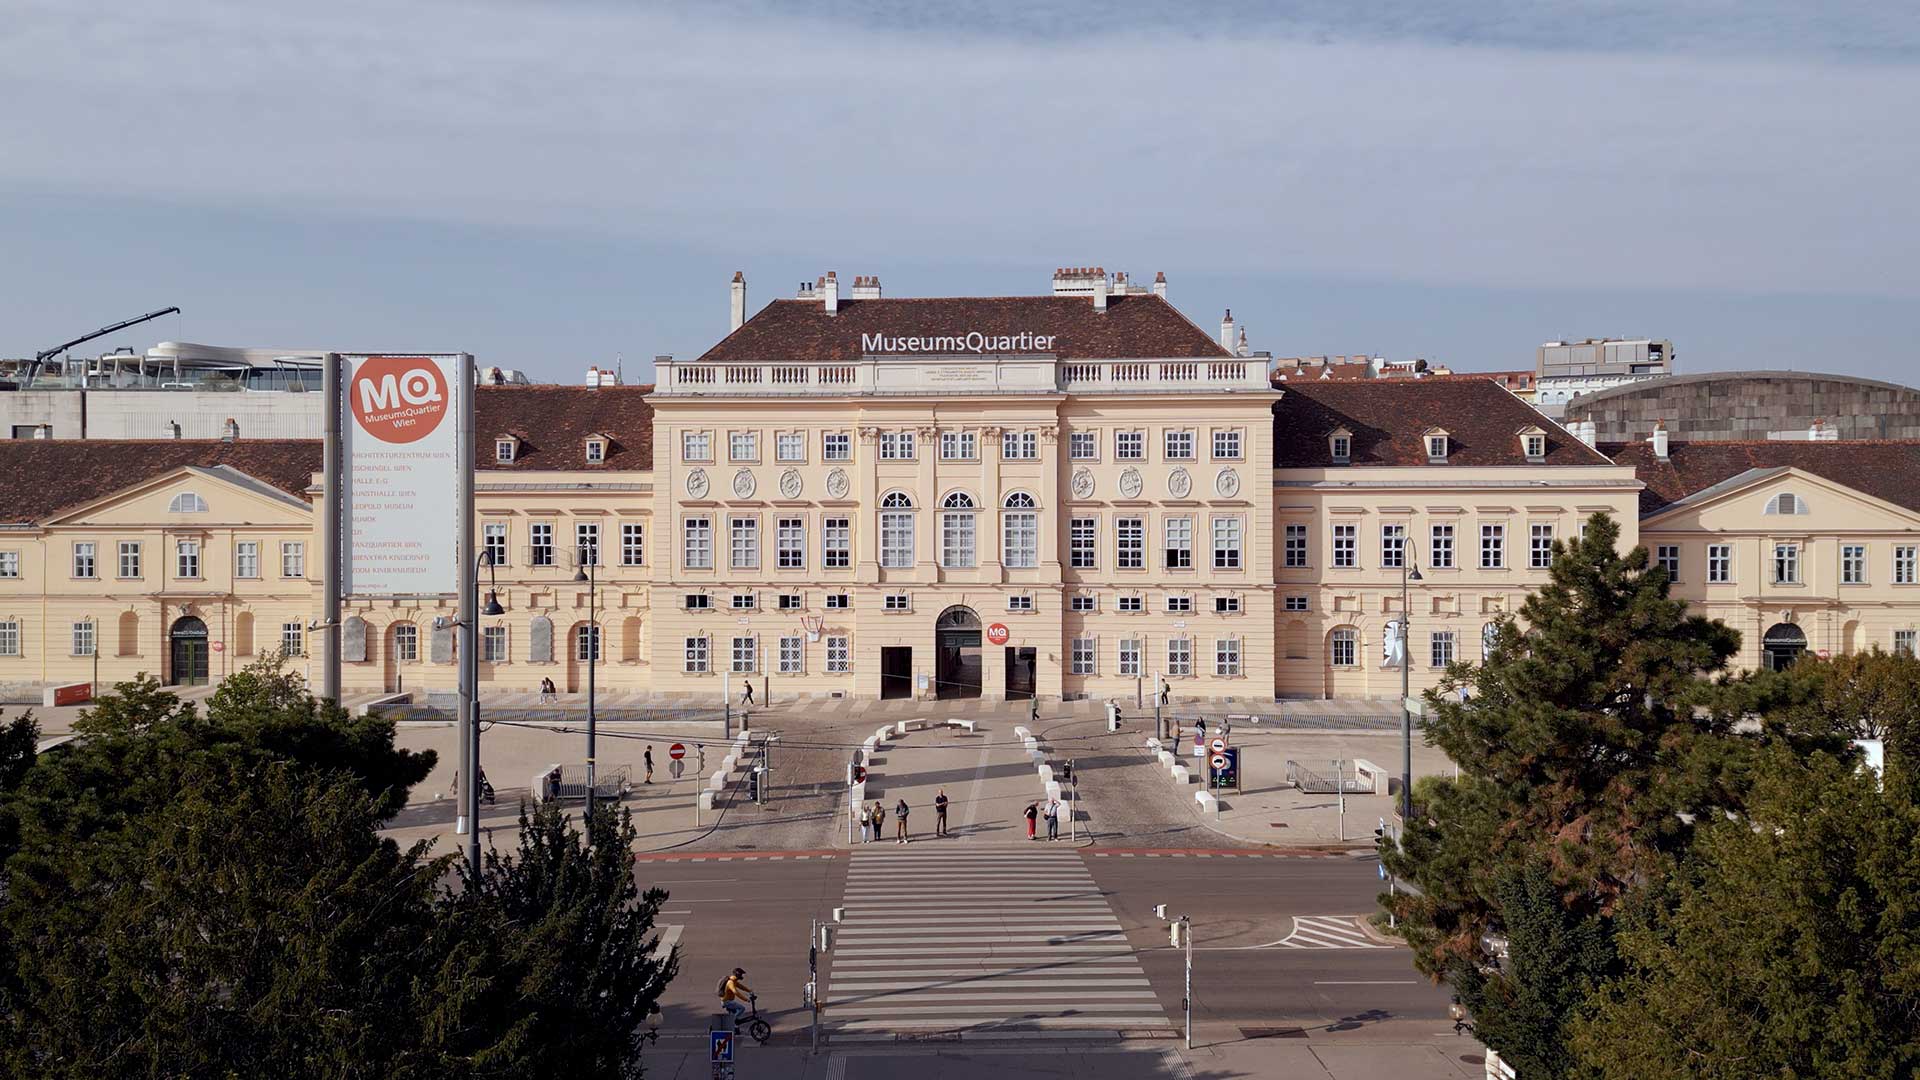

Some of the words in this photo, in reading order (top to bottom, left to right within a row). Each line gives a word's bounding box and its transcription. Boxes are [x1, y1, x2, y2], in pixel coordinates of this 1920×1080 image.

[862, 331, 1056, 353] MuseumsQuartier
[359, 368, 442, 413] MQ
[365, 404, 440, 423] MuseumsQuartier
[392, 418, 416, 428] Wien
[989, 627, 1006, 636] MQ
